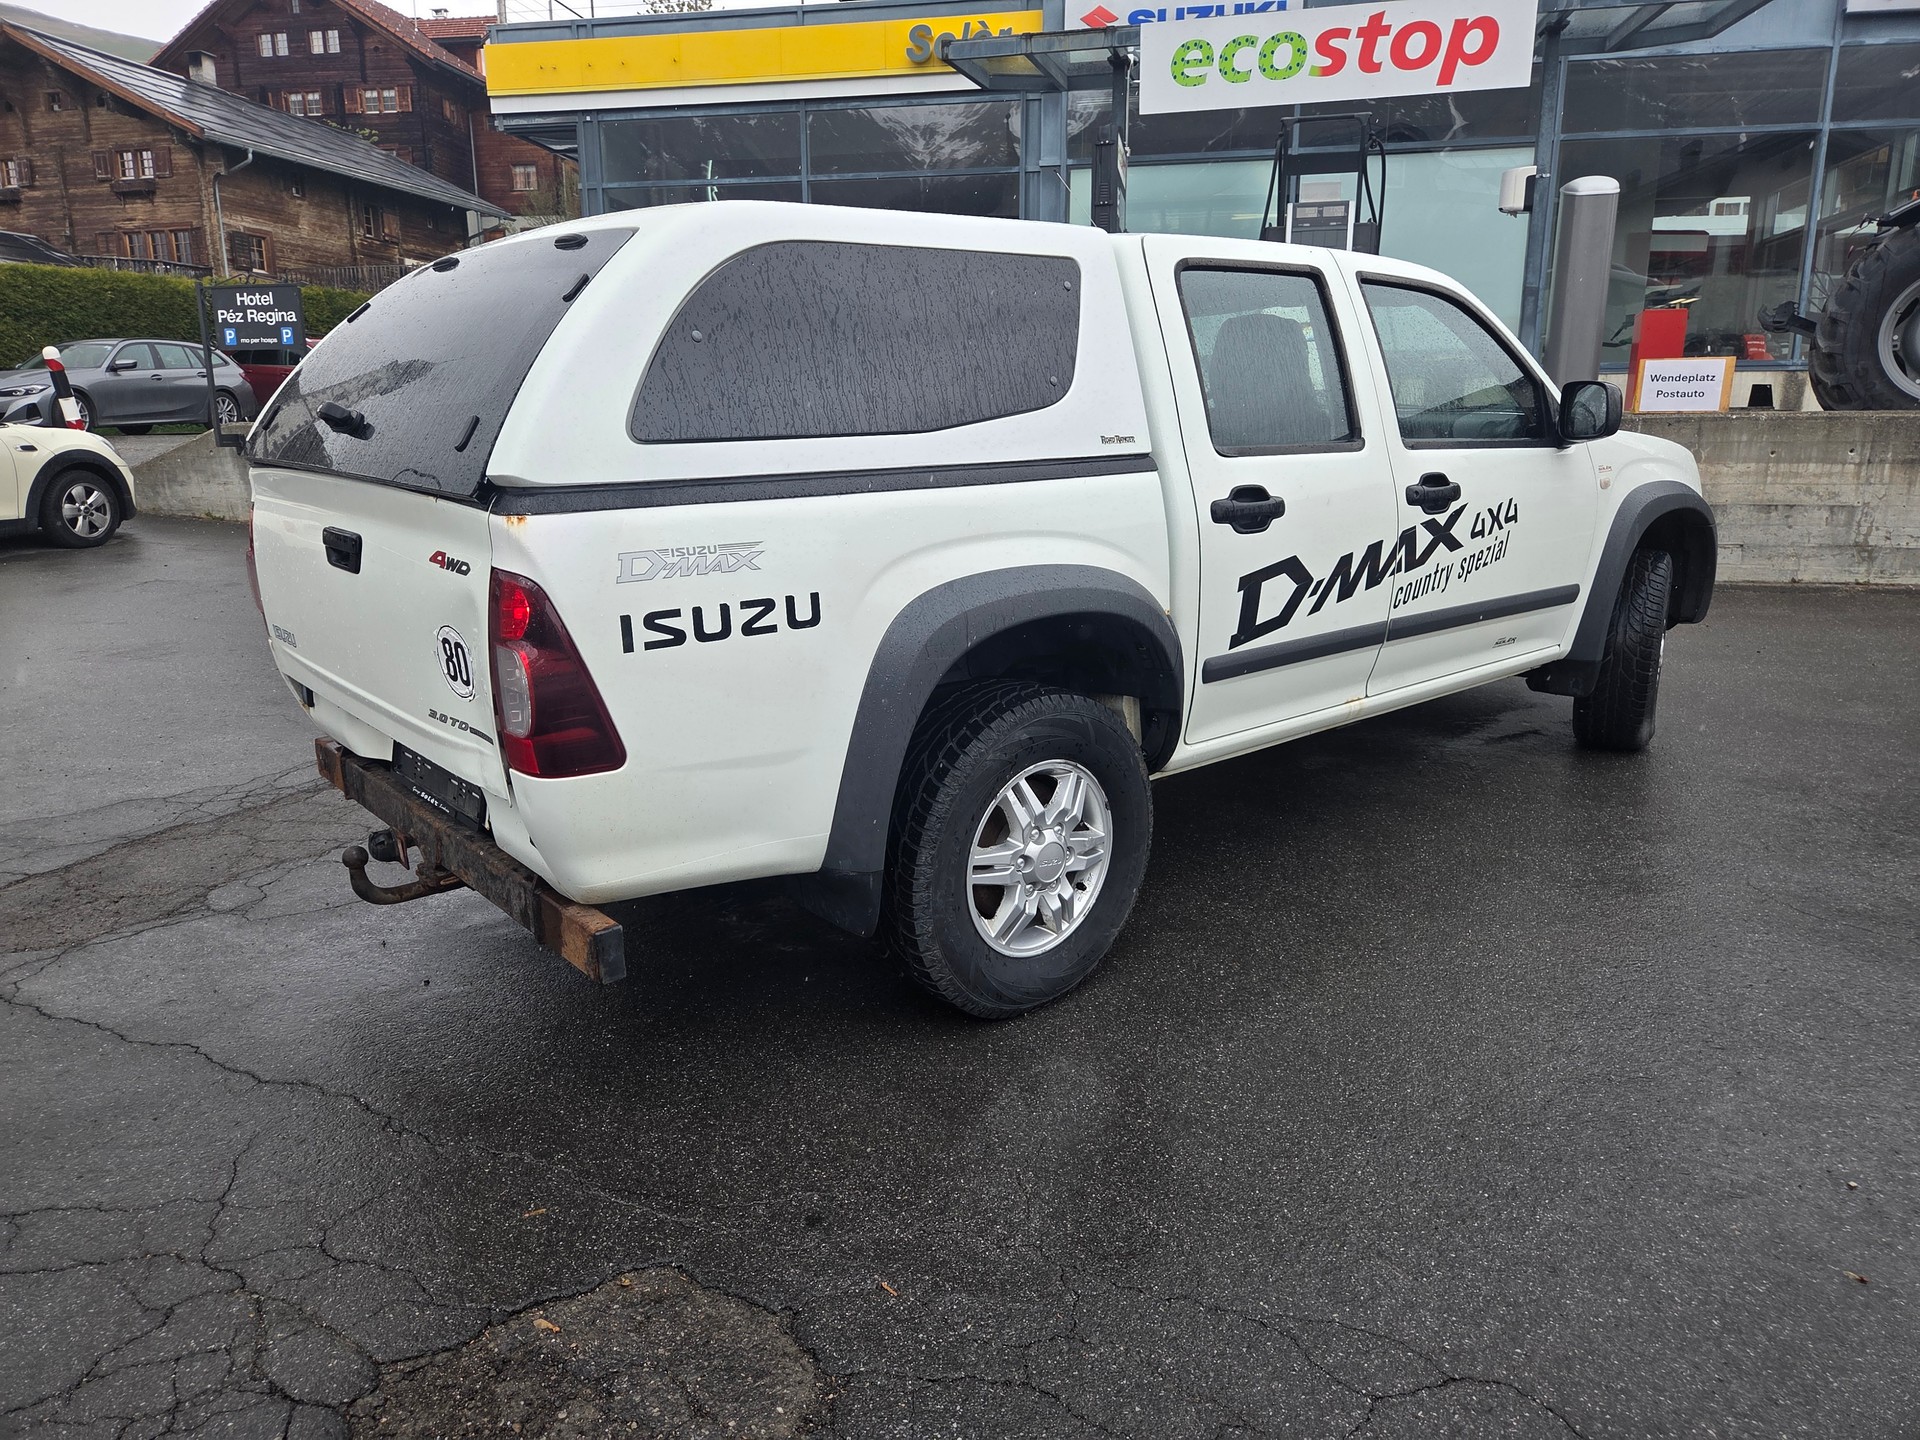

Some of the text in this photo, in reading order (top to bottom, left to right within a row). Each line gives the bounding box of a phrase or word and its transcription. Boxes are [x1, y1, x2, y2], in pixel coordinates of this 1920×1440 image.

[1170, 9, 1500, 87] ecostop
[236, 291, 274, 306] Hotel
[217, 308, 297, 326] Péz Regina
[1650, 373, 1716, 384] Wendeplatz
[1656, 389, 1705, 398] Postauto
[429, 550, 471, 576] 4WD
[670, 545, 718, 558] ISUZU
[1228, 502, 1468, 650] D-MAX
[1393, 530, 1511, 610] country spezial
[619, 591, 822, 654] ISUZU
[441, 637, 471, 687] 80
